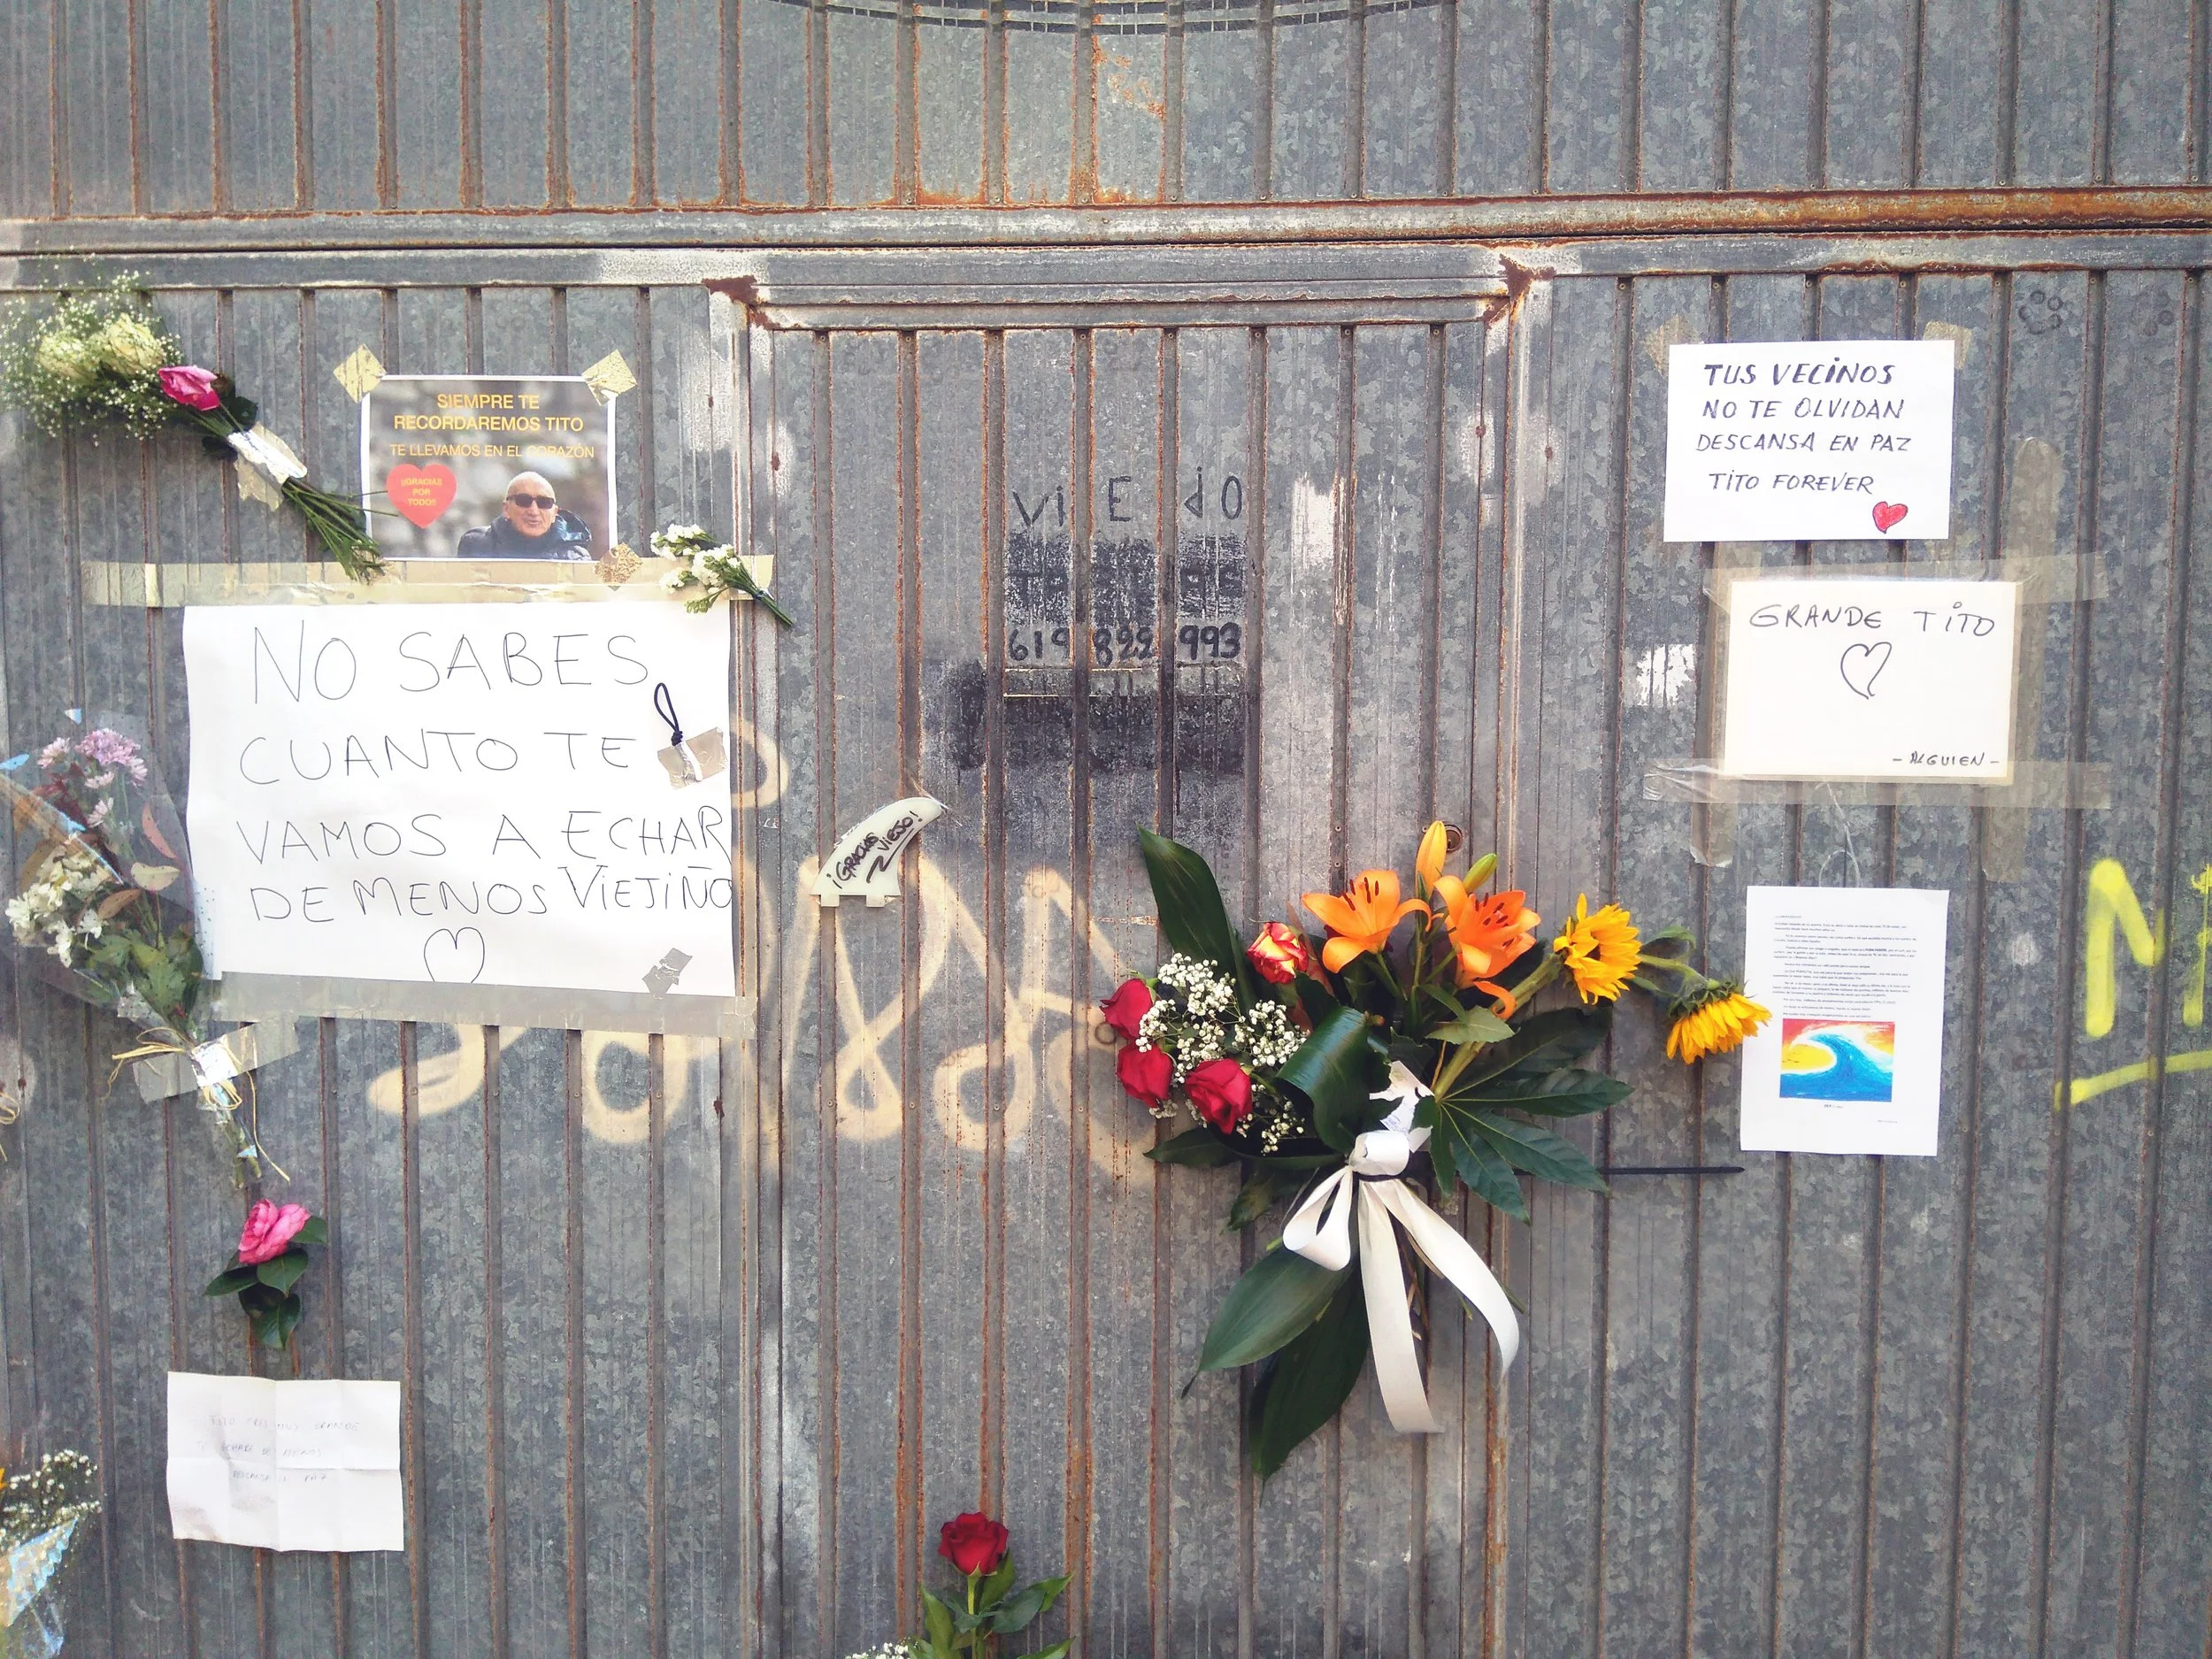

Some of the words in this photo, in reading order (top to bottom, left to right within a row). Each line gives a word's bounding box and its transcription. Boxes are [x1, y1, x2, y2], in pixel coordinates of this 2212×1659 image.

[1704, 362, 1756, 386] TUS
[437, 394, 513, 409] SIEMPRE
[518, 395, 540, 410] TE
[1702, 399, 1737, 419] NO
[1749, 400, 1782, 419] TE
[1794, 397, 1904, 419] OLVIDAN
[394, 415, 540, 432] RECORDAREMOS
[545, 417, 584, 433] TITO
[389, 443, 404, 456] TE
[410, 443, 480, 457] LLEVAMOS
[484, 444, 503, 457] EN
[507, 445, 523, 457] EL
[526, 443, 595, 458] CORAZÓN
[1696, 432, 1815, 452] DESCANSA
[1829, 434, 1858, 452] EN
[1870, 434, 1911, 452] PAZ
[412, 488, 431, 496] POR
[1772, 472, 1873, 495] FOREVER
[1749, 604, 1882, 628] GRANDE
[1009, 626, 1071, 661] 619
[1179, 622, 1242, 660] 993
[254, 619, 357, 704] NO
[399, 632, 649, 692] SABES
[240, 728, 518, 784] CUANTO
[543, 732, 636, 770] TE
[236, 814, 446, 864] VAMOS
[492, 815, 541, 859] A
[561, 806, 731, 864] ECHAR
[250, 887, 334, 923] DE
[353, 877, 547, 917] MENOS
